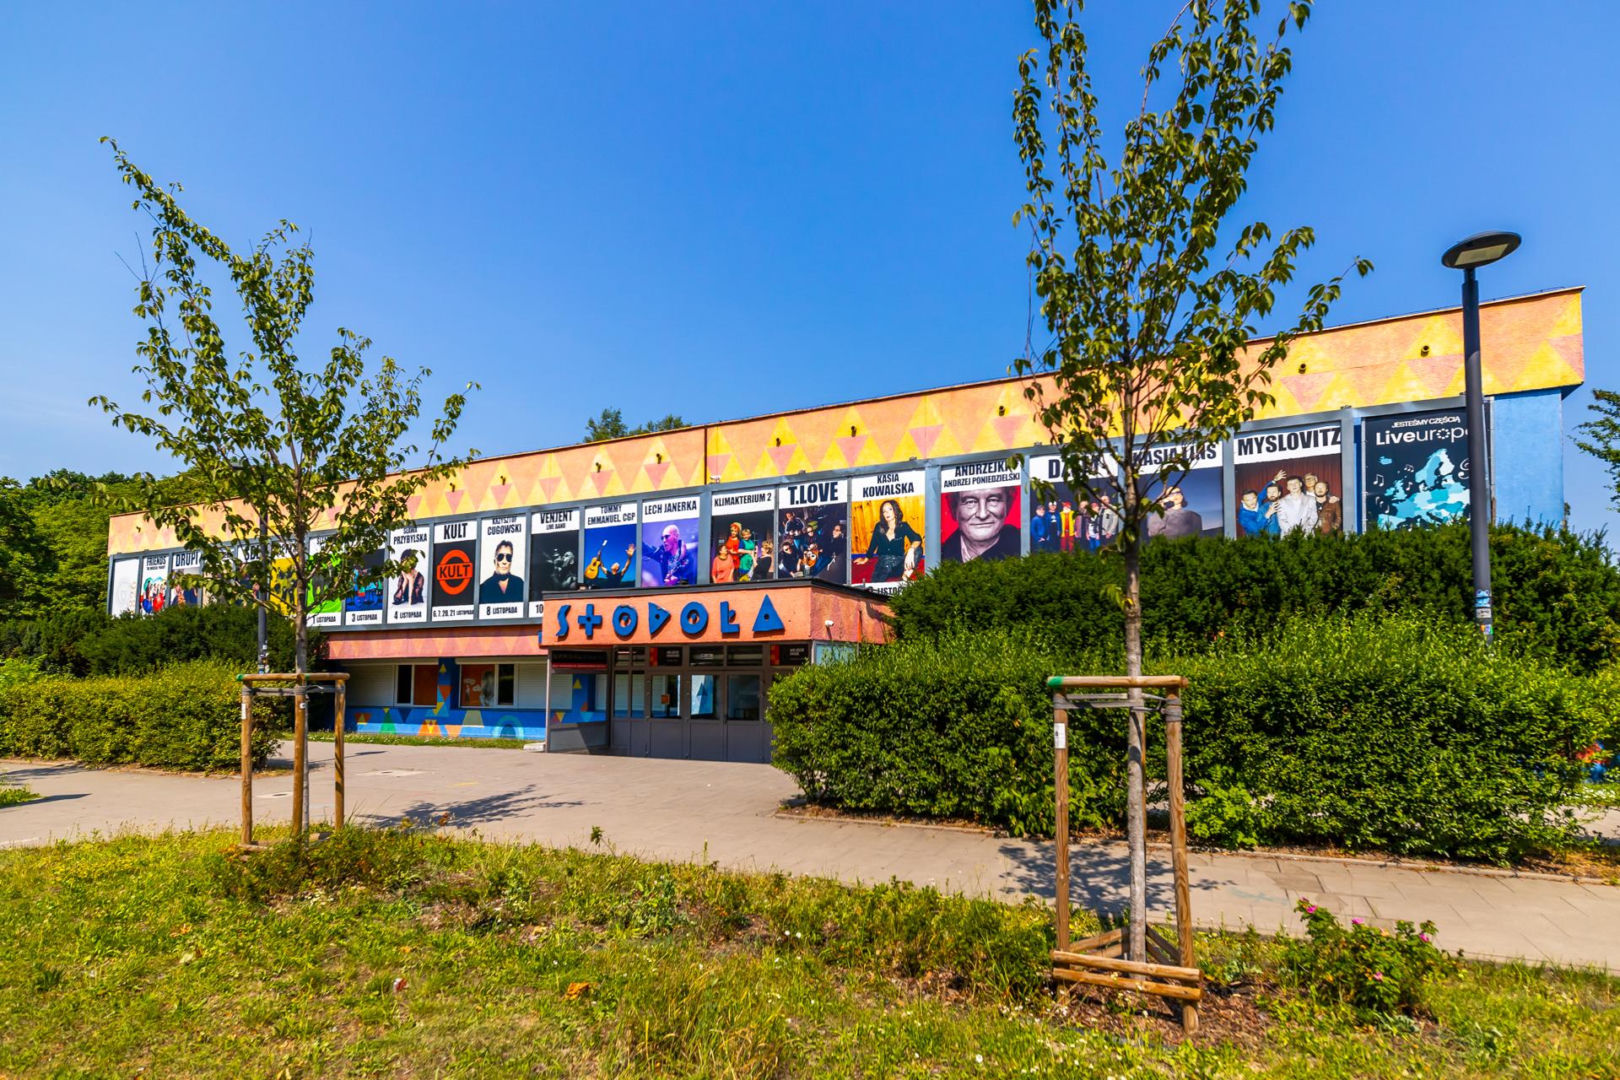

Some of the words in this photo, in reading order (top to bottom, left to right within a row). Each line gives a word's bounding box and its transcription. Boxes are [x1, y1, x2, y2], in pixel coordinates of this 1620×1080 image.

[1238, 427, 1341, 456] MYSLOVITZ
[1376, 427, 1468, 446] Liveurop
[877, 473, 899, 484] KASIA
[944, 477, 971, 488] ANDRZEJ
[972, 473, 1020, 485] PONIEDZIELSKI
[788, 481, 838, 505] T.LOVE
[862, 482, 914, 498] KOWALSKA
[714, 493, 766, 507] KLIMAKTERIUM
[767, 492, 772, 502] 2
[645, 504, 662, 515] LECH
[664, 500, 697, 513] JANERKA
[443, 522, 468, 540] KULT
[440, 564, 470, 578] KULT
[486, 606, 491, 616] 8
[493, 606, 518, 614] LISTOPADA
